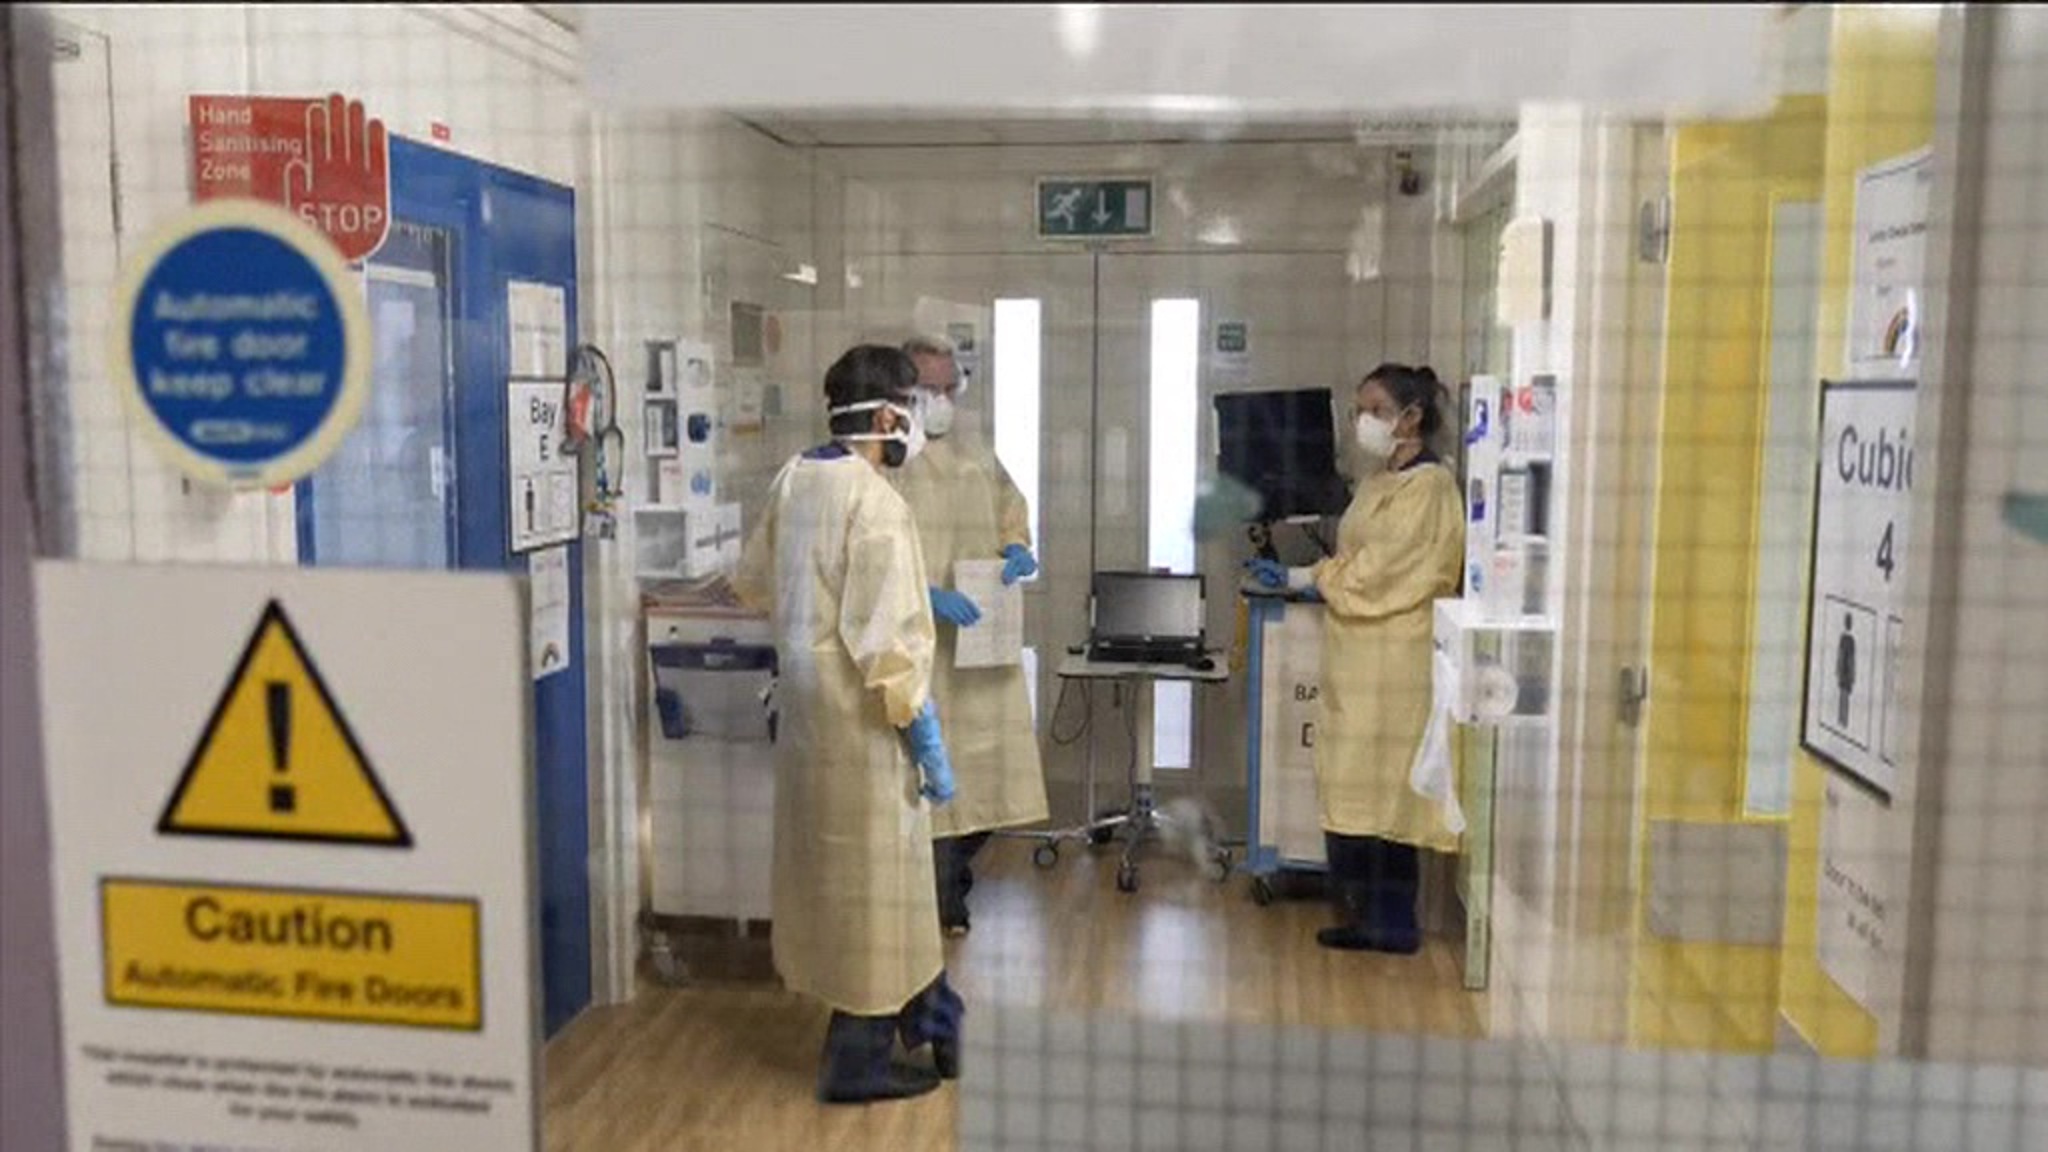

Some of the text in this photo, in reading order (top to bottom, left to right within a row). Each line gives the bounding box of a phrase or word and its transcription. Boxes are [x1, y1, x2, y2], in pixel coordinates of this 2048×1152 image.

[201, 103, 252, 125] Hand
[201, 132, 303, 154] Sanitising
[202, 159, 250, 180] Zone
[301, 203, 382, 233] STOP
[156, 291, 319, 321] Automatic
[231, 331, 308, 360] door
[153, 368, 325, 401] keep clear
[530, 396, 557, 428] Bay
[540, 435, 549, 461] E
[1875, 521, 1895, 583] 4
[184, 896, 394, 953] Caution
[124, 959, 464, 1010] Automatic Fire Doors
